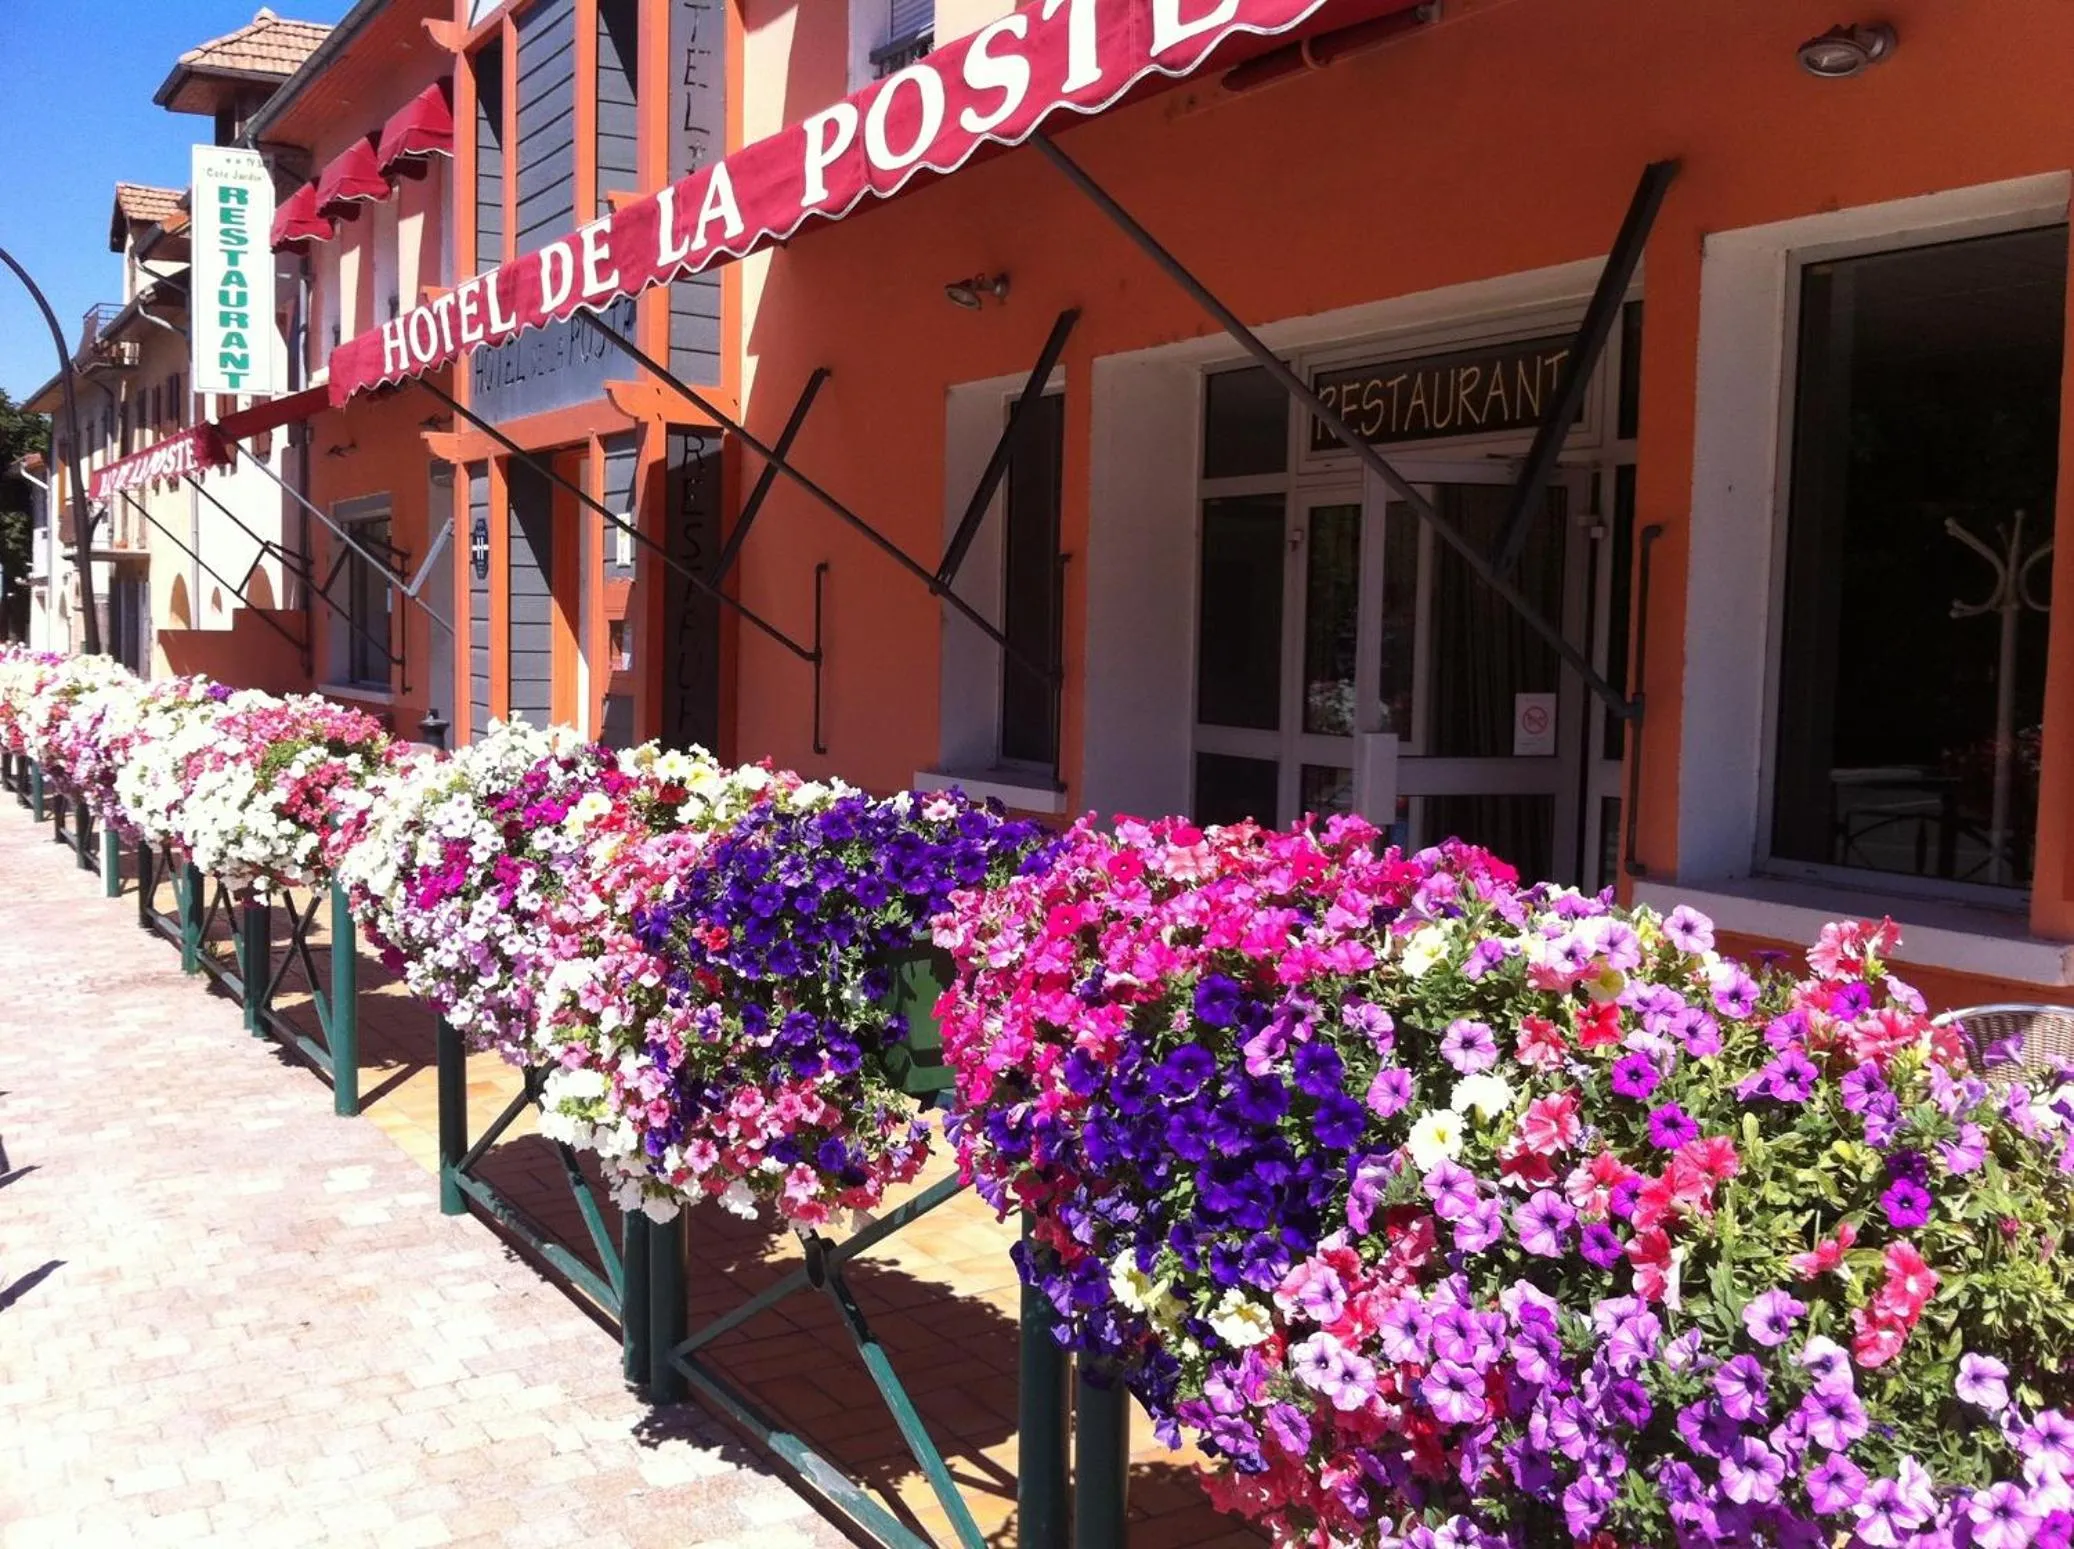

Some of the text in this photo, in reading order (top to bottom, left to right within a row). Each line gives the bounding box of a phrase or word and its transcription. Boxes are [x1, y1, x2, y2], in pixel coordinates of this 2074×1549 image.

[218, 186, 251, 389] RESTAURANT
[383, 267, 516, 374] HOTEL
[539, 217, 619, 313] DE
[657, 161, 745, 267] LA
[1315, 350, 1570, 441] RESTAURANT
